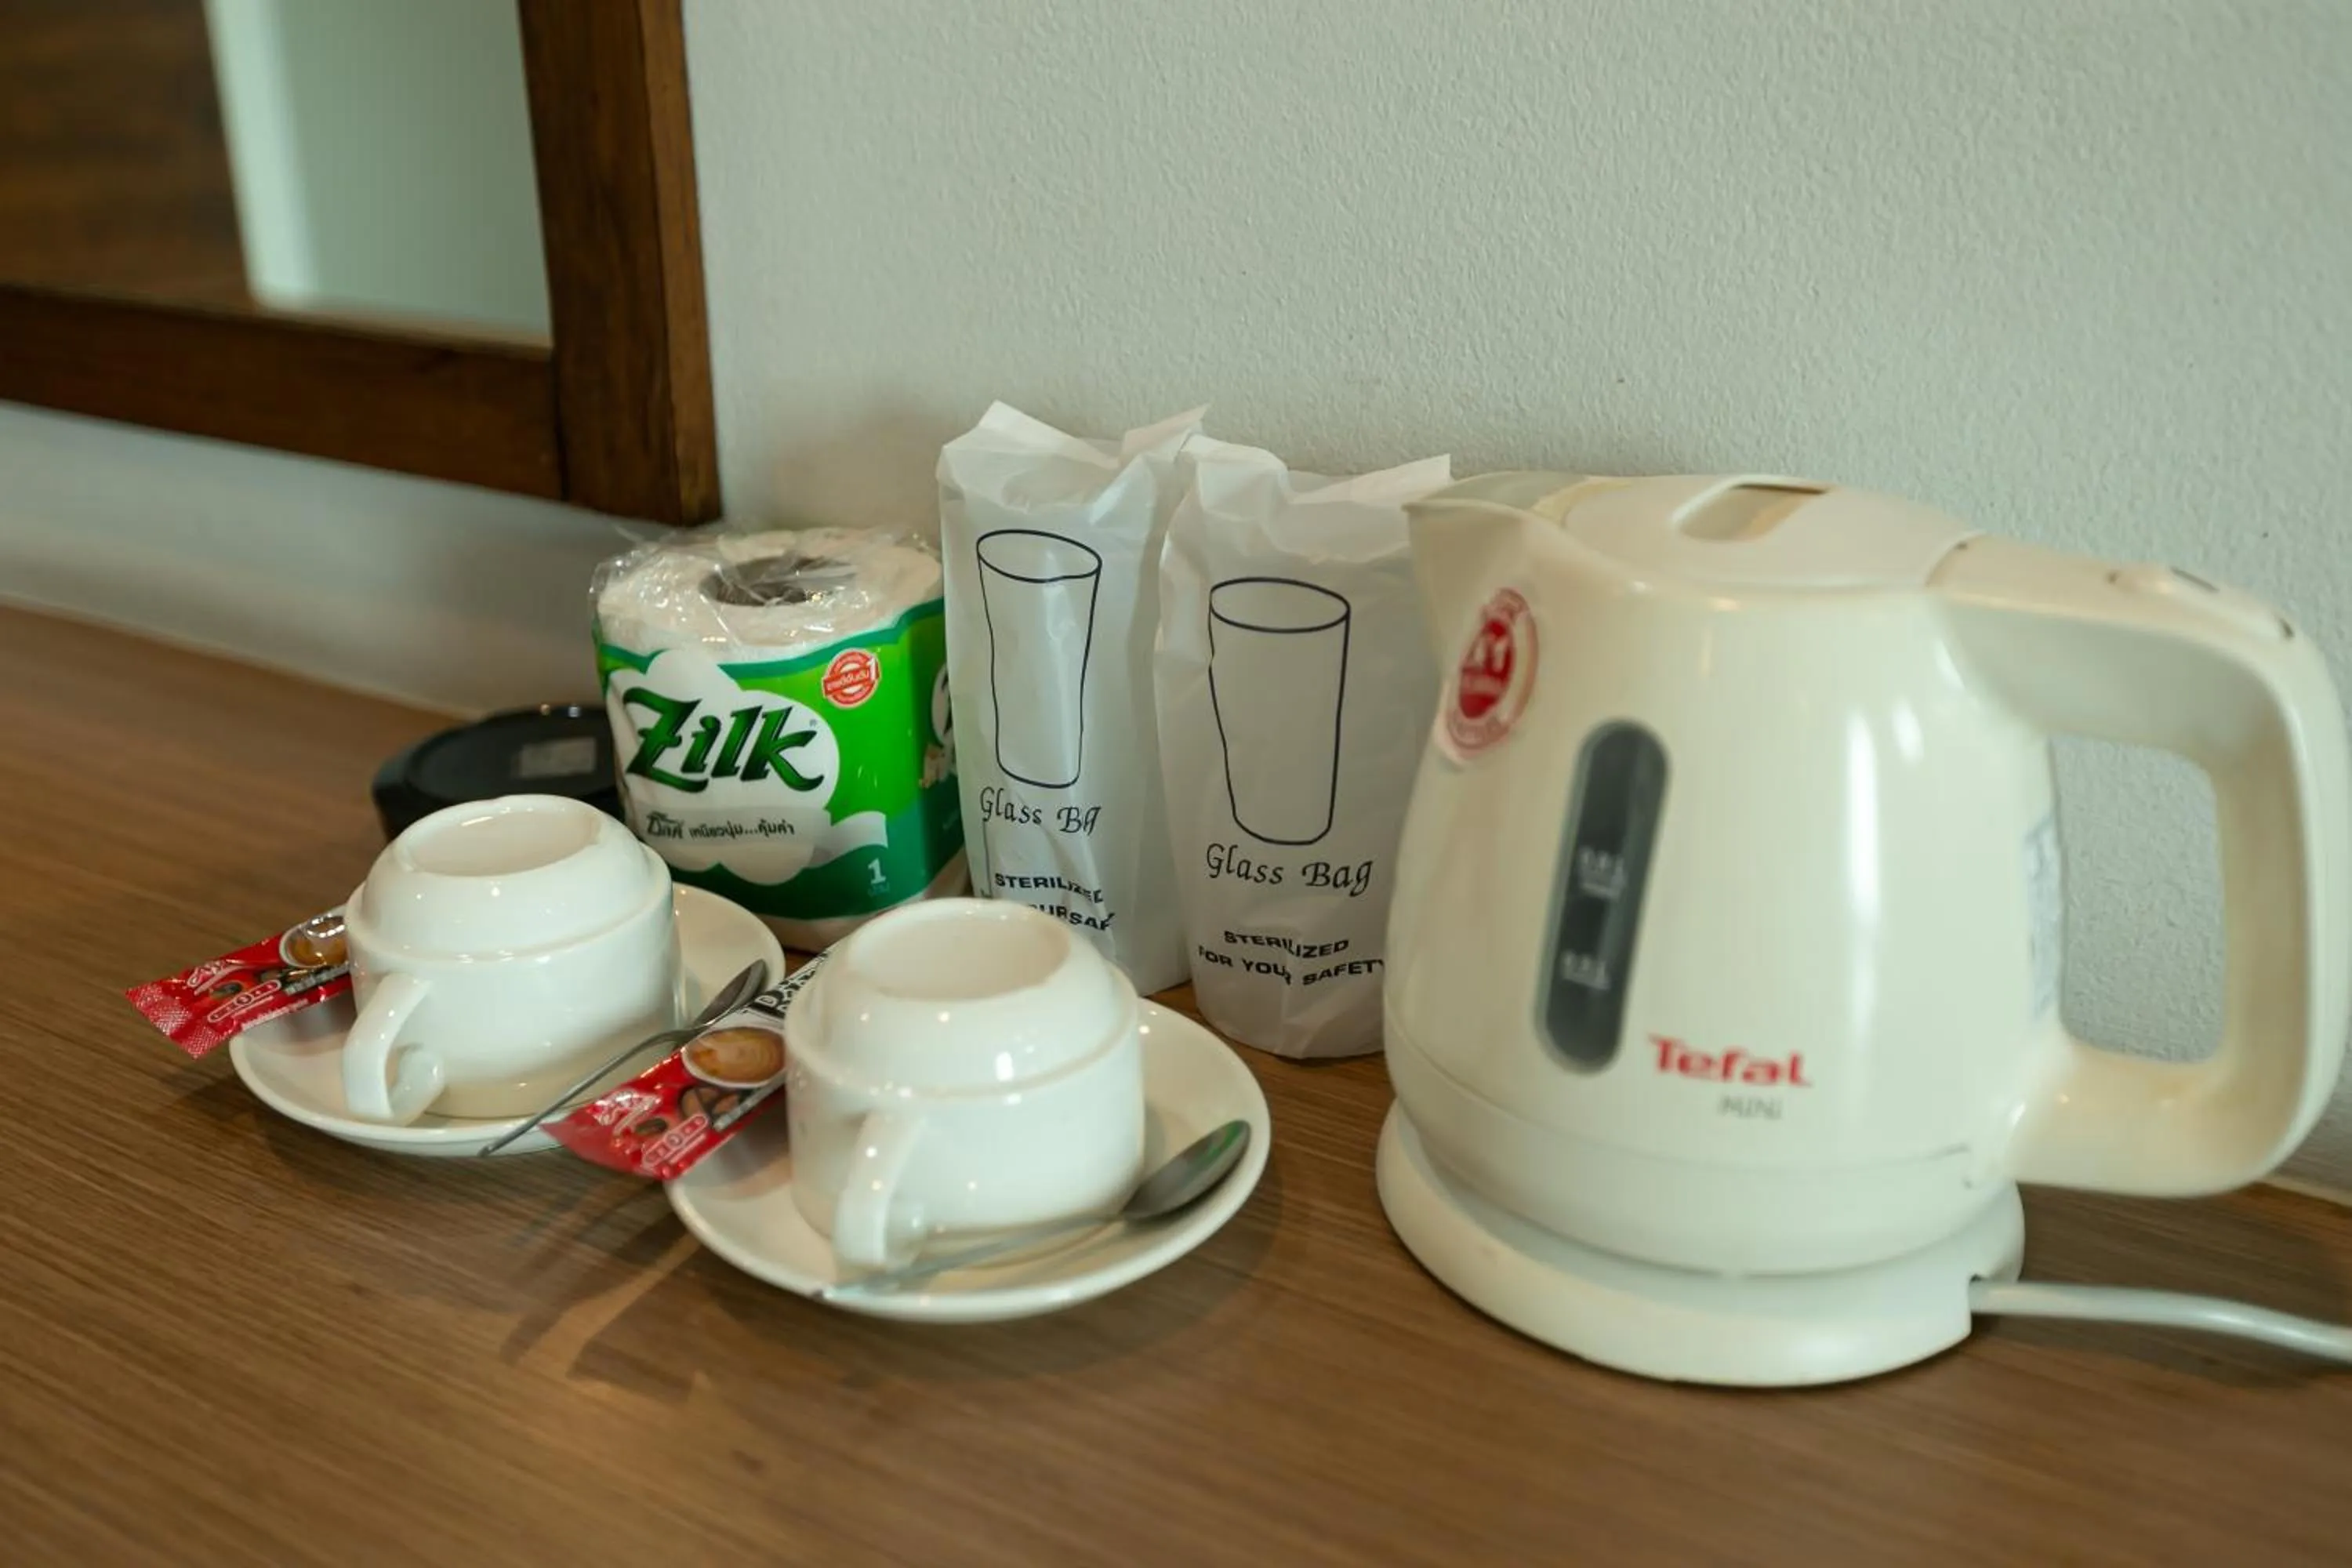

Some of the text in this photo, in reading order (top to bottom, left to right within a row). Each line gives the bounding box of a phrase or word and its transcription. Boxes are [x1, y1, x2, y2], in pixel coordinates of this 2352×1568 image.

[622, 686, 825, 793] Zilk
[980, 786, 1044, 826] Glass
[867, 858, 887, 884] 1
[1207, 843, 1374, 898] Glass Bag
[1224, 930, 1350, 959] STERILIZED
[1648, 1033, 1813, 1088] Tefal
